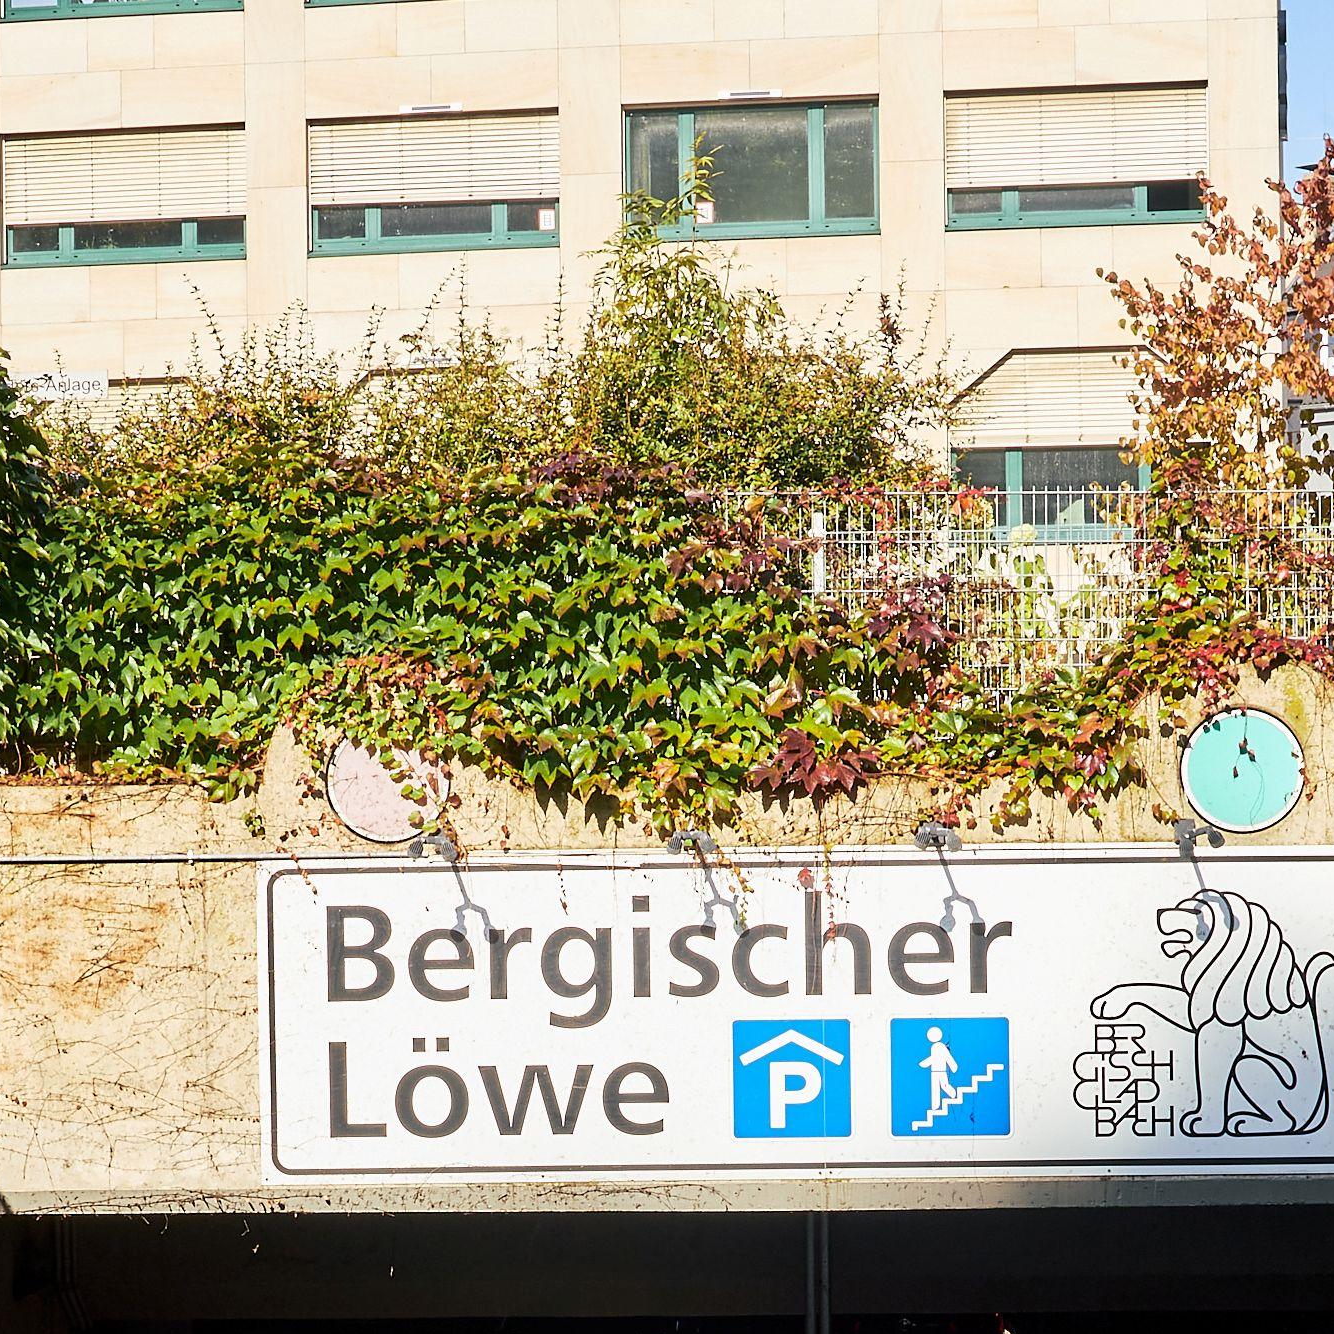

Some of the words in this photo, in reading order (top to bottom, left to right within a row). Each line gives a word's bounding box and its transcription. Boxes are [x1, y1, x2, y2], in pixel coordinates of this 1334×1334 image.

[326, 890, 1013, 1029] Bergischer
[328, 1037, 670, 1138] Löwe
[769, 1061, 822, 1129] P
